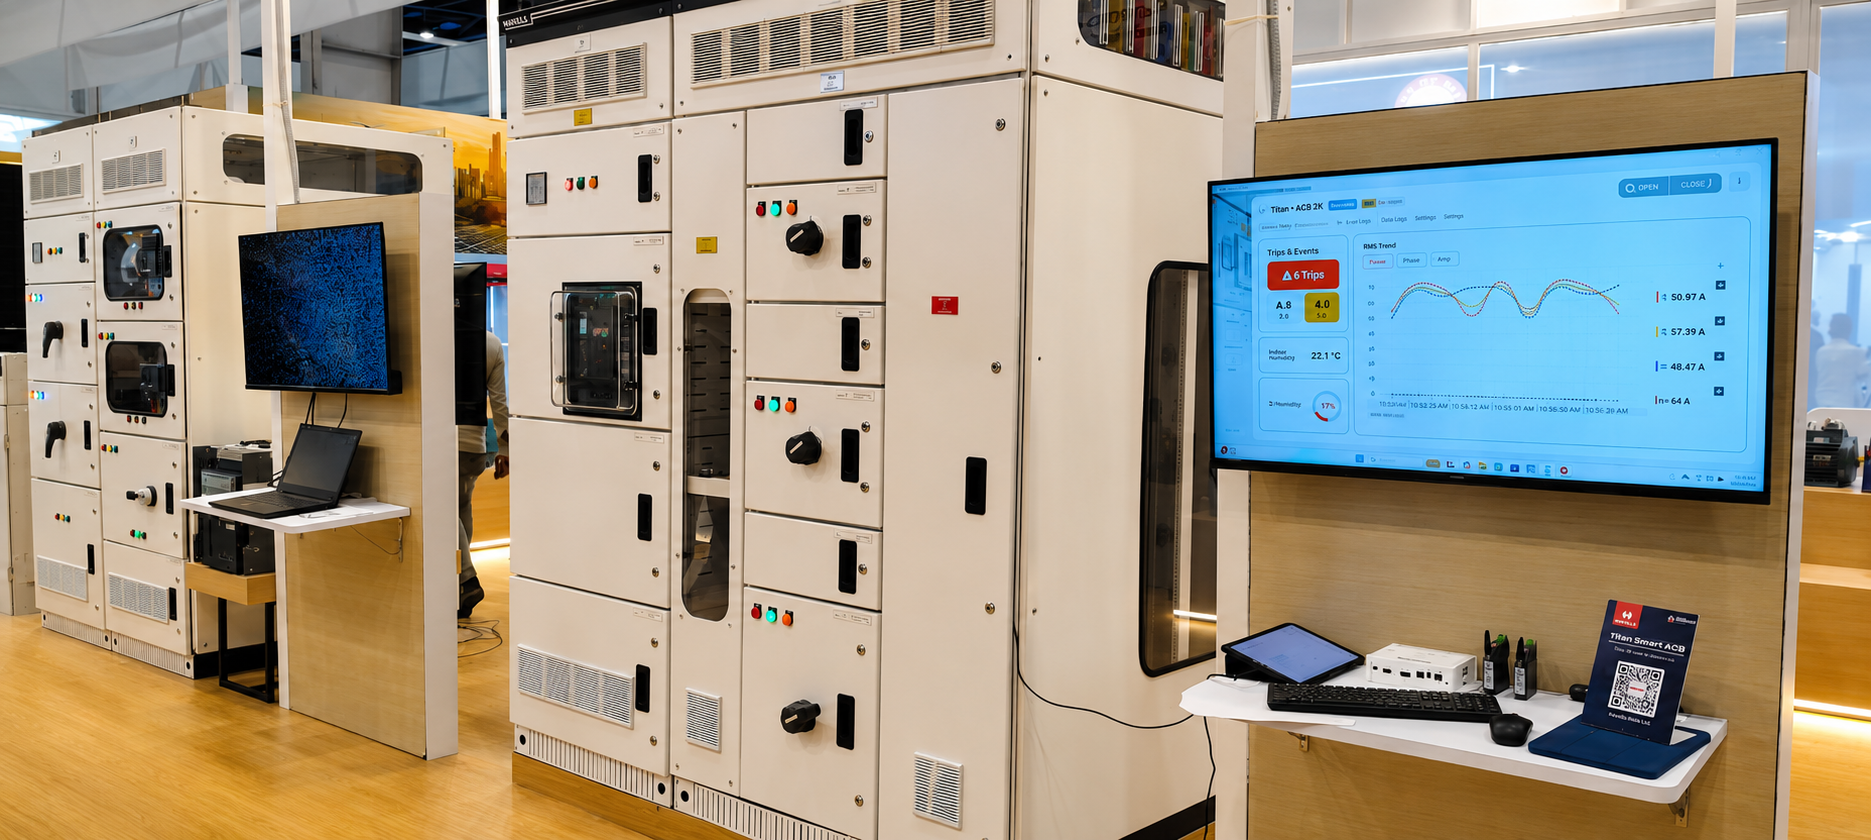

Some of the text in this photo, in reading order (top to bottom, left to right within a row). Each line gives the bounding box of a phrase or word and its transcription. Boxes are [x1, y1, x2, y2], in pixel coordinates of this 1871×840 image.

[1268, 249, 1285, 257] Trips
[1294, 270, 1324, 281] 6 Trips
[1699, 293, 1706, 301] A
[1315, 300, 1330, 308] 4.0
[1670, 363, 1705, 371] 48.47 A
[1634, 637, 1662, 649] Smart
[1664, 643, 1686, 653] ACB
